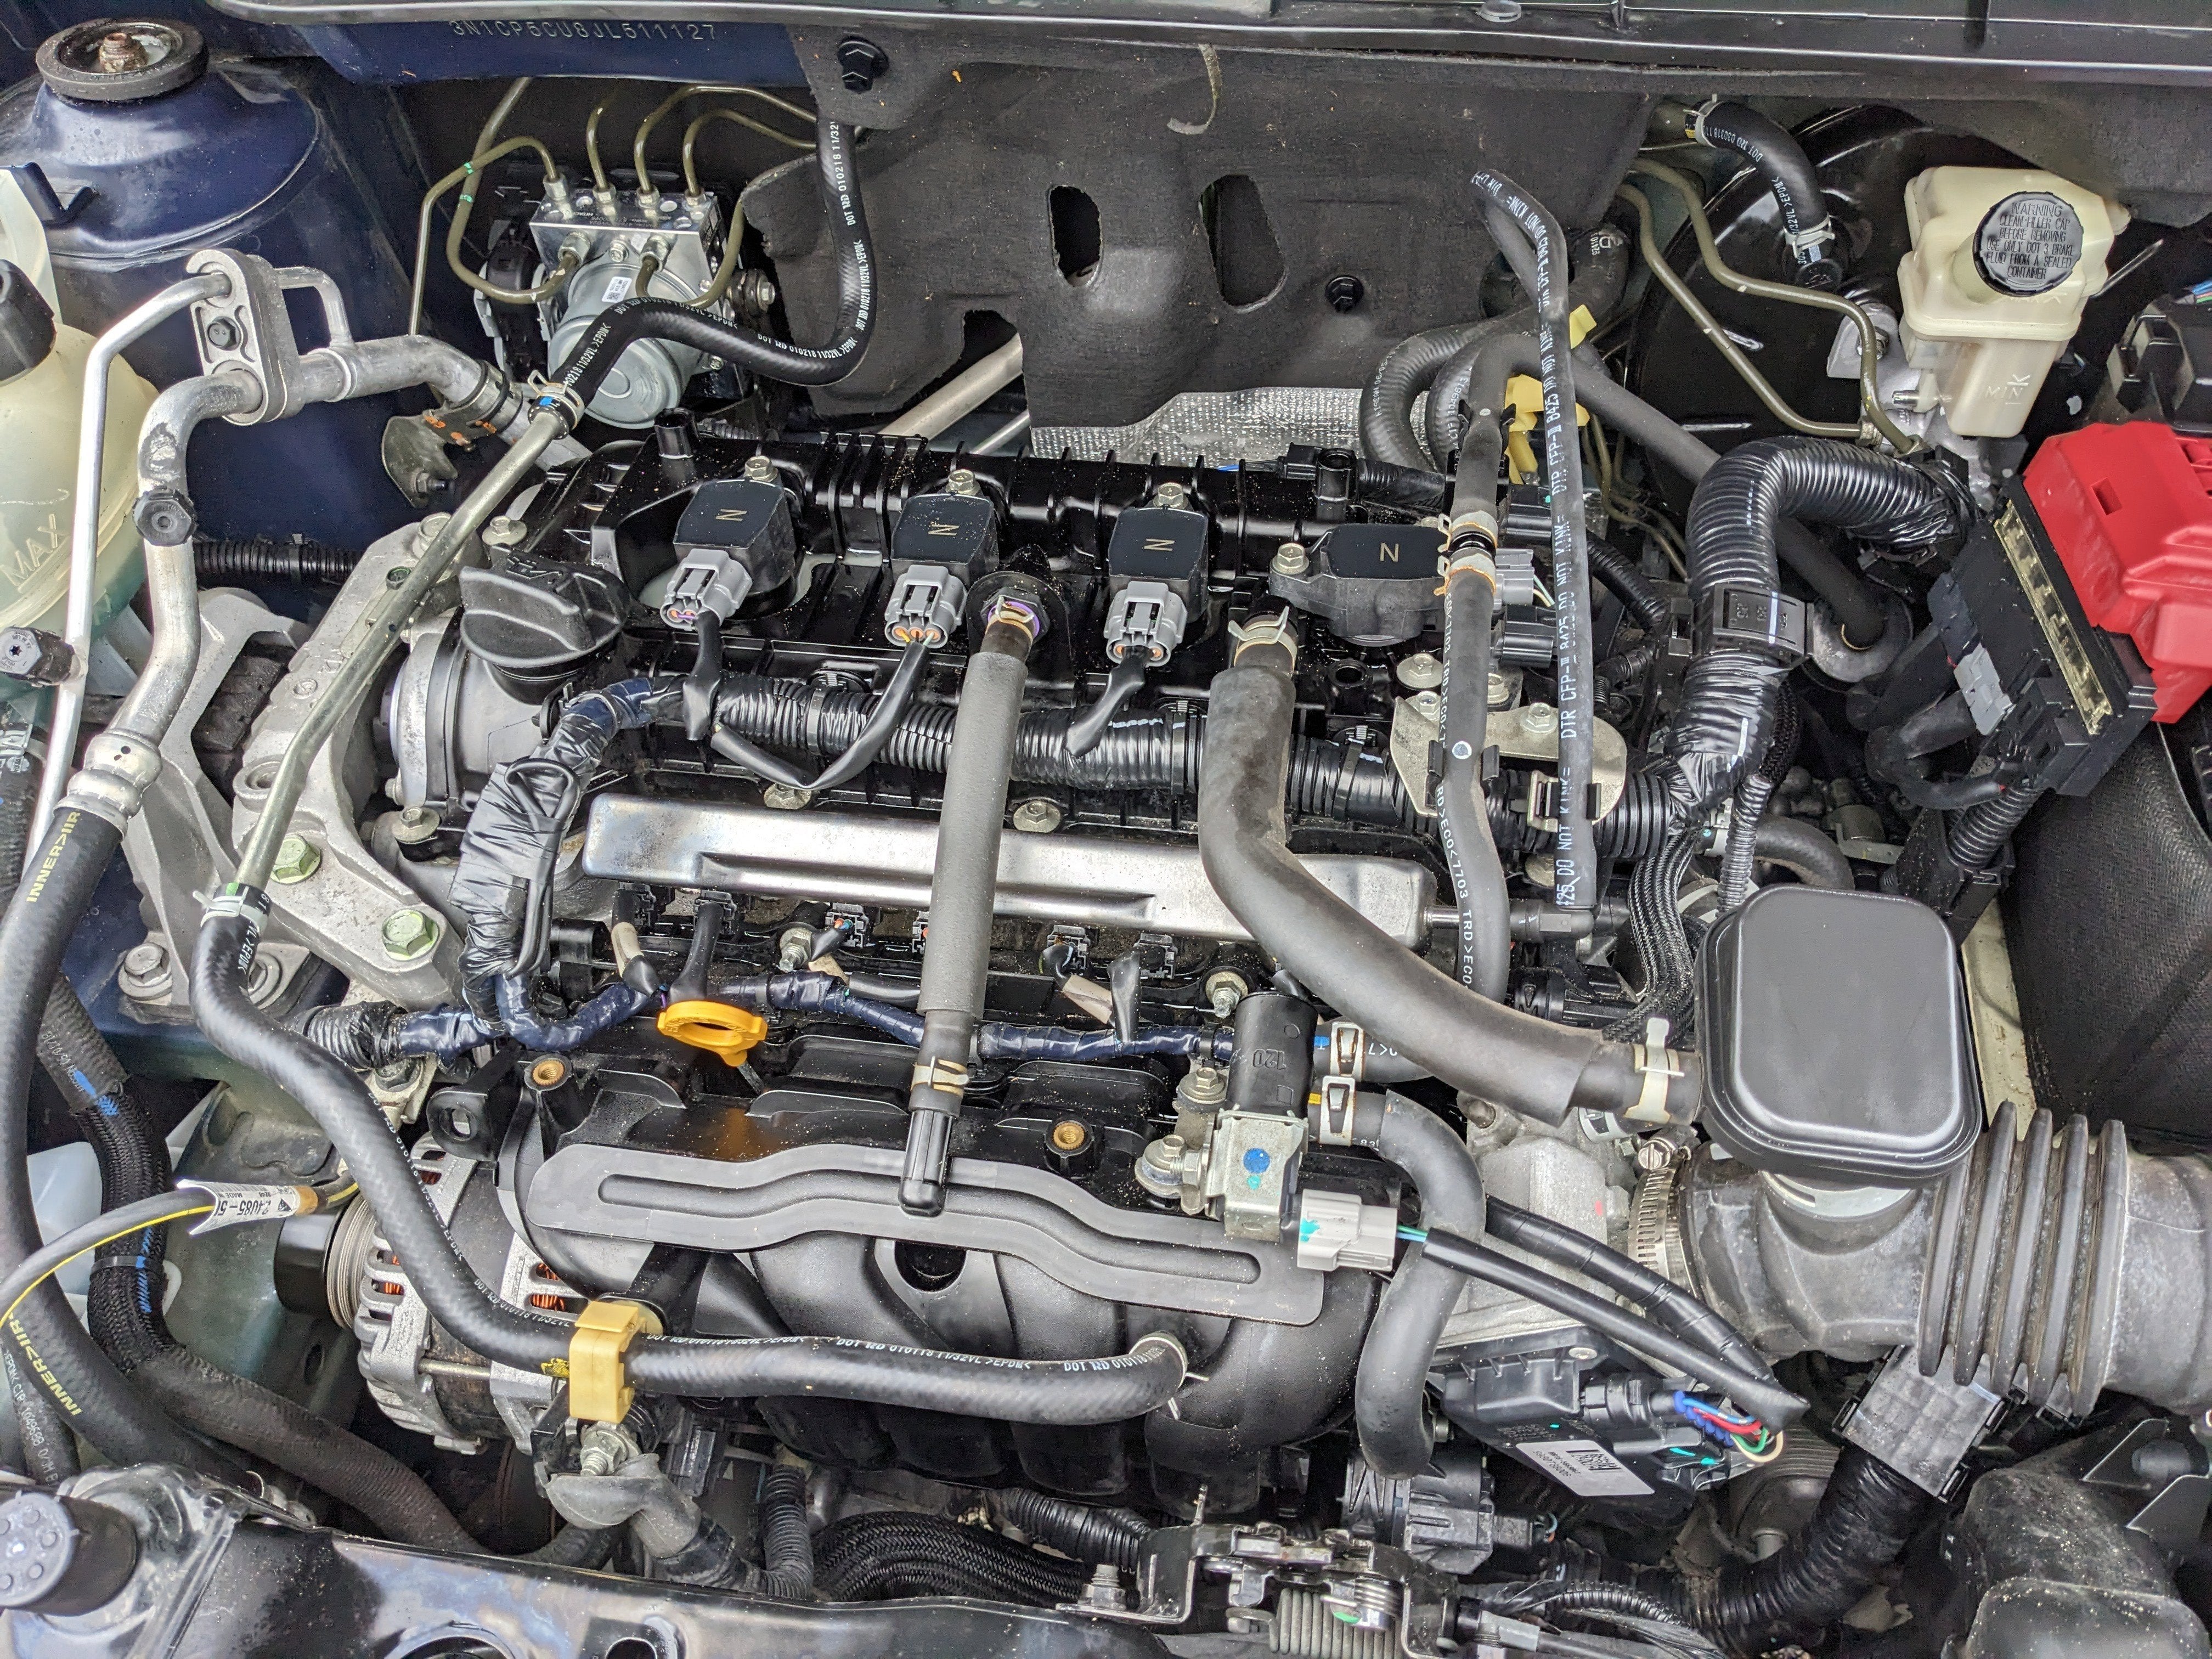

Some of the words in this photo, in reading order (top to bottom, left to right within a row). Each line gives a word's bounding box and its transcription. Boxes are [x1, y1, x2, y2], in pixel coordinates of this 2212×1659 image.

[449, 20, 715, 40] 3N1CP5CU8JL511127
[1748, 145, 1763, 162] DOT
[833, 154, 847, 191] 010218
[844, 211, 856, 225] DOT
[2012, 202, 2063, 217] WARNING
[2000, 215, 2024, 227] CLEAN
[2027, 217, 2051, 229] FILLER
[2000, 227, 2027, 240] BEFORE
[2031, 229, 2067, 242] REMOVING
[1987, 238, 2000, 251] USE
[2004, 240, 2022, 252] ONLY
[2027, 241, 2041, 253] DOT
[2044, 244, 2049, 255] 3
[2052, 244, 2074, 256] BRAKE
[1986, 252, 2006, 264] FLUID
[2010, 253, 2030, 266] FROM
[2034, 255, 2039, 266] A
[2044, 255, 2072, 268] SEALED
[2007, 266, 2047, 279] CONTAINER
[860, 289, 870, 310] 010218
[758, 334, 771, 344] DOT
[789, 346, 816, 358] 010218
[1985, 386, 2023, 399] MIN
[1545, 393, 1561, 424] B425
[0, 514, 66, 586] MAX
[1379, 543, 1400, 562] N
[1561, 709, 1577, 738] DTR
[1557, 824, 1573, 850] NOT
[1556, 860, 1575, 876] DO
[1252, 1048, 1286, 1070] 120
[836, 1338, 859, 1348] DOT
[1064, 1362, 1086, 1372] DOT
[1111, 1353, 1148, 1368] 010118
